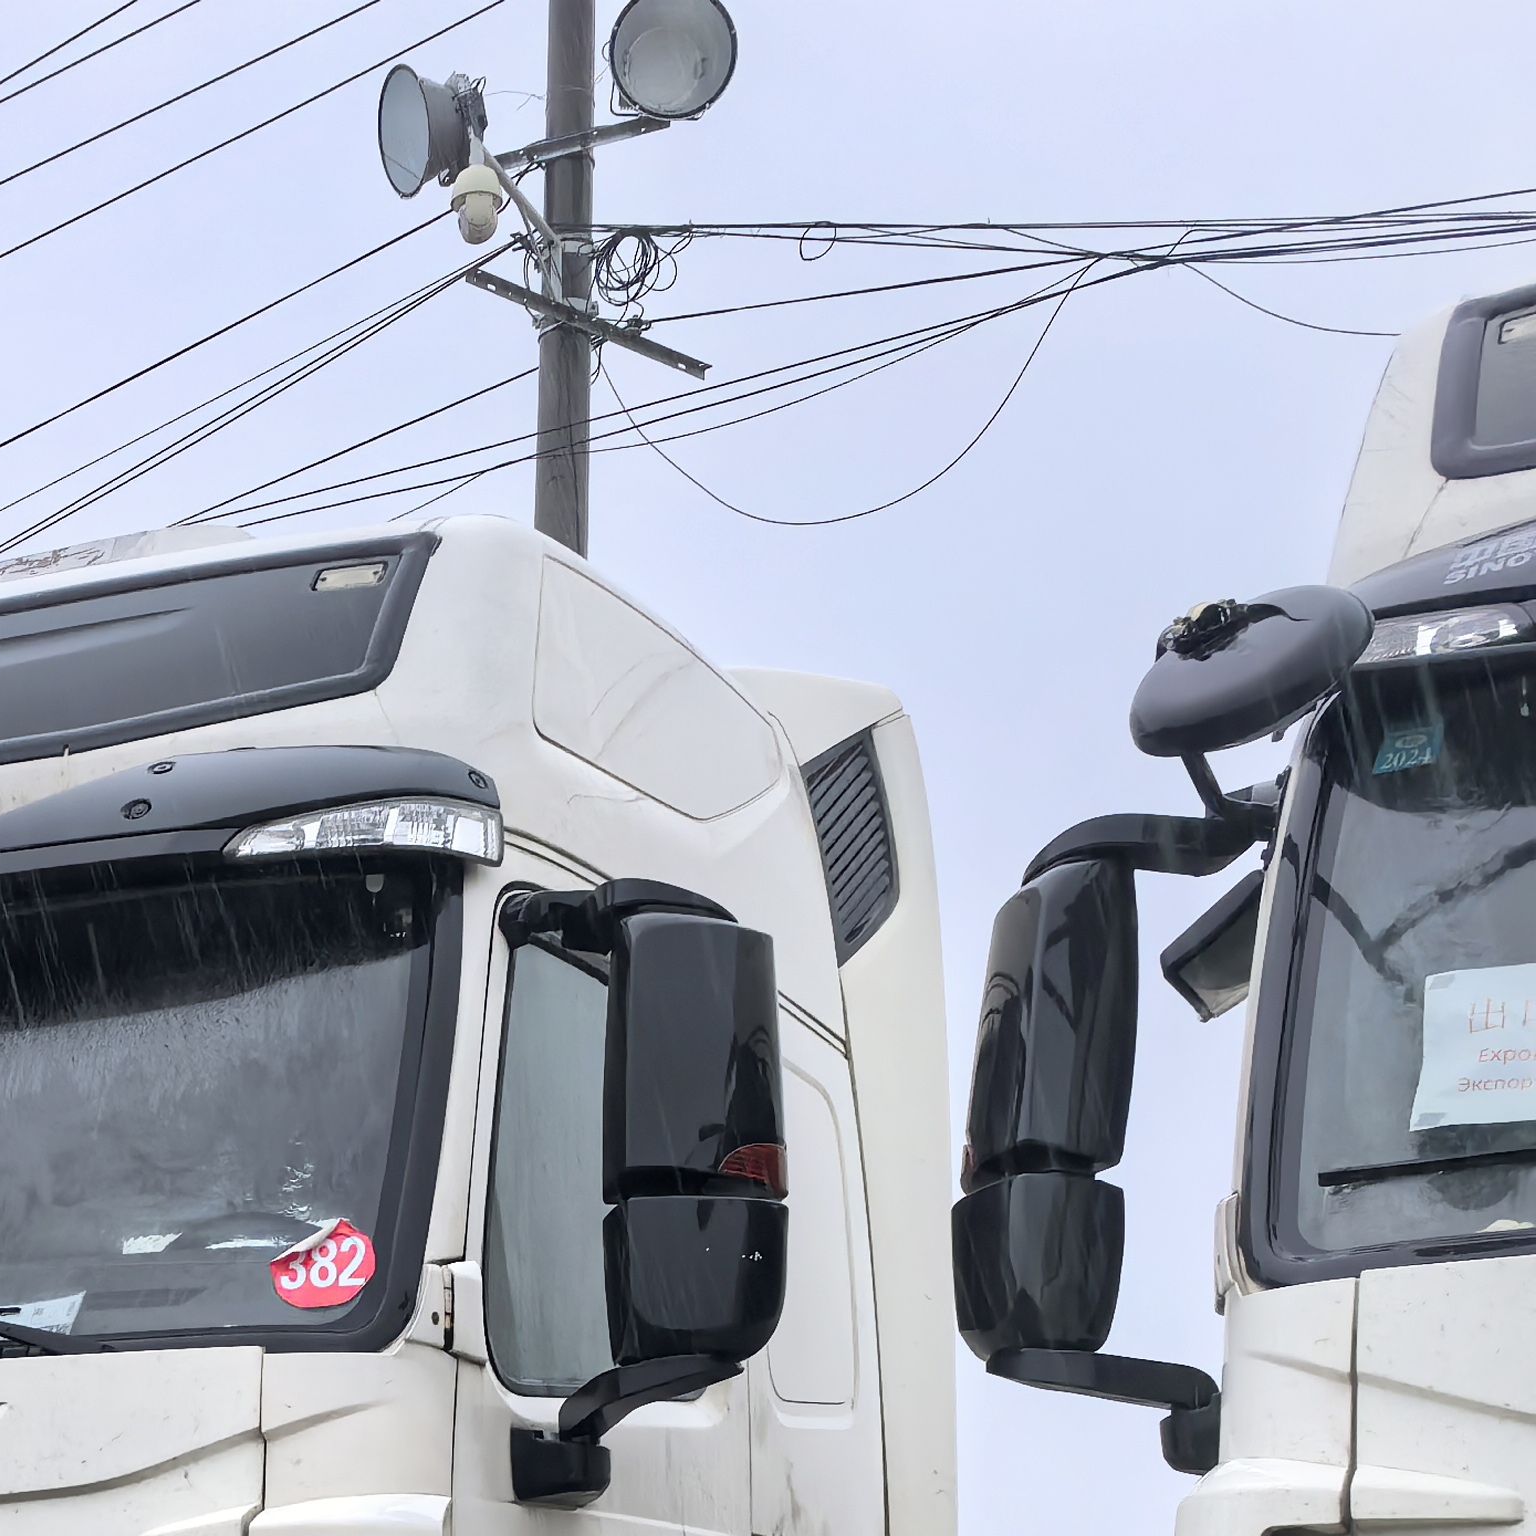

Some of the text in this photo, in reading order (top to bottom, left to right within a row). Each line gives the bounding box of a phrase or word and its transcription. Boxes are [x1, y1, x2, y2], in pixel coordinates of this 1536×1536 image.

[1443, 549, 1536, 585] SINO
[1379, 747, 1432, 770] 2024
[1478, 1046, 1536, 1066] Expo
[1458, 1077, 1536, 1093] Экспор
[280, 1236, 366, 1290] 382
